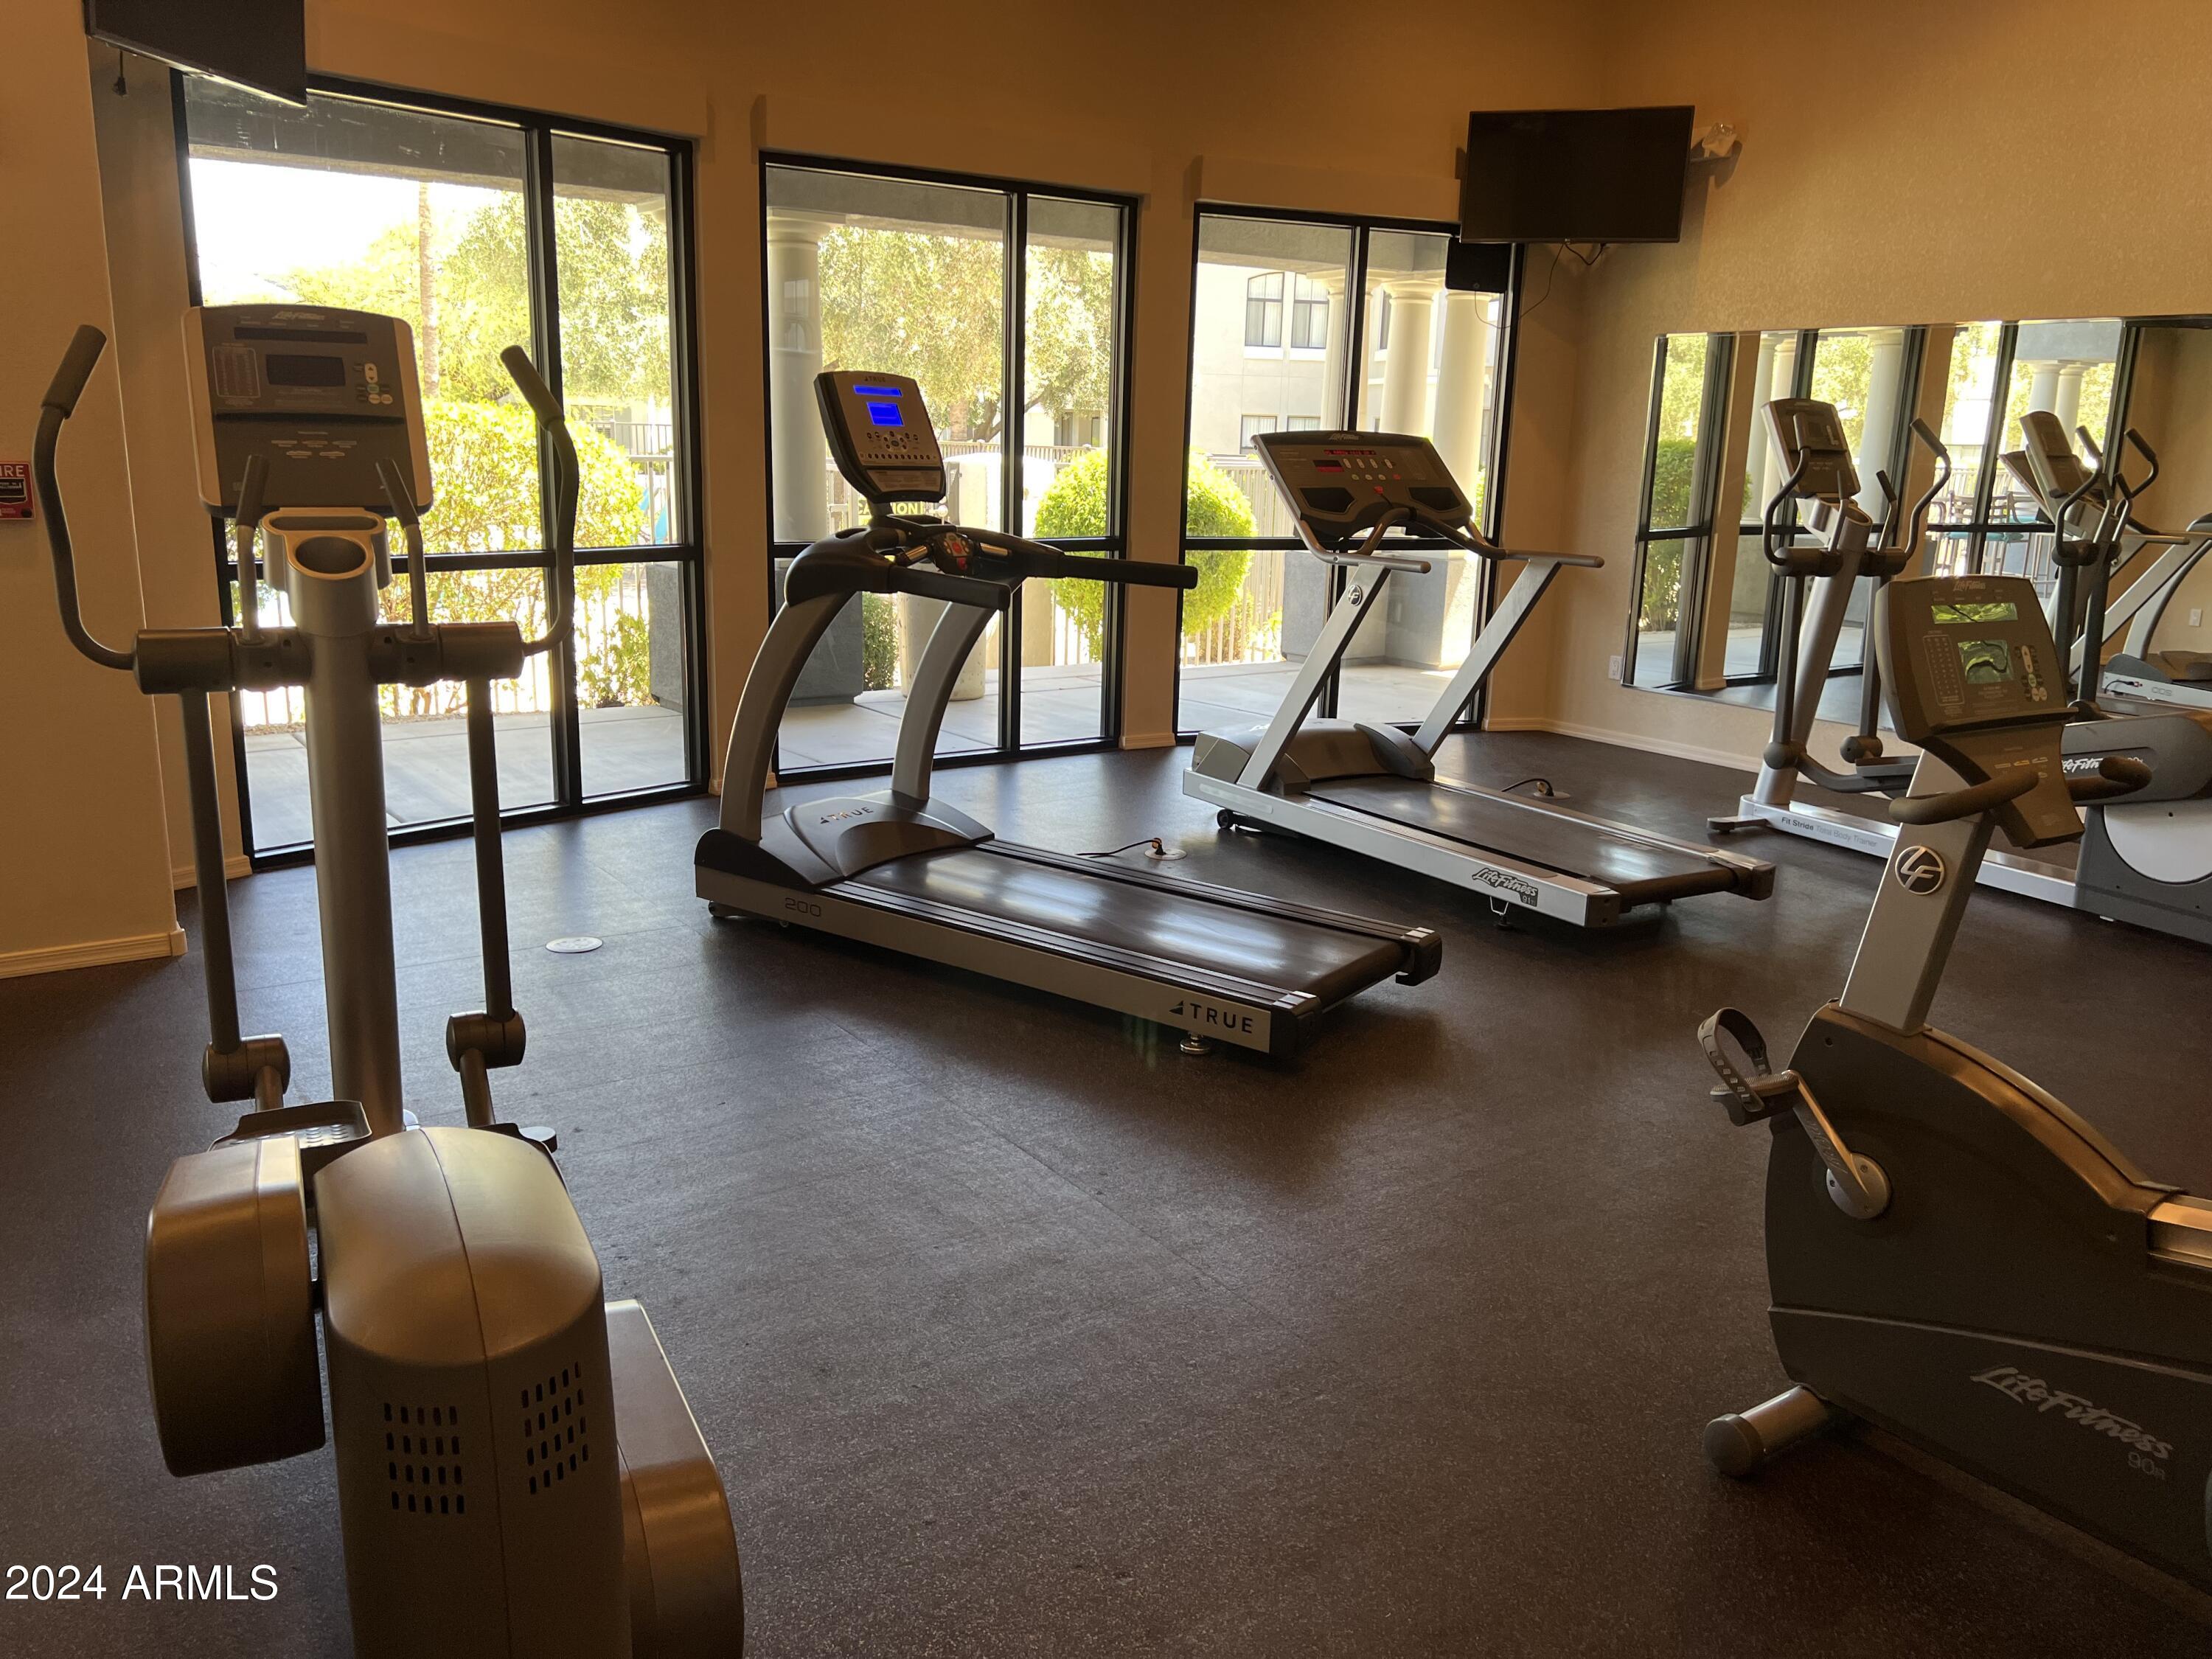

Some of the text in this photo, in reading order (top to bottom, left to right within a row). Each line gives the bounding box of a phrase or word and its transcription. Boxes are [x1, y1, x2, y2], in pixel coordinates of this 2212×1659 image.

[827, 807, 873, 821] TRUE
[1781, 817, 1791, 825] Fit
[1792, 819, 1814, 831] Stride
[785, 897, 821, 917] 200
[1190, 1003, 1253, 1034] TRUE
